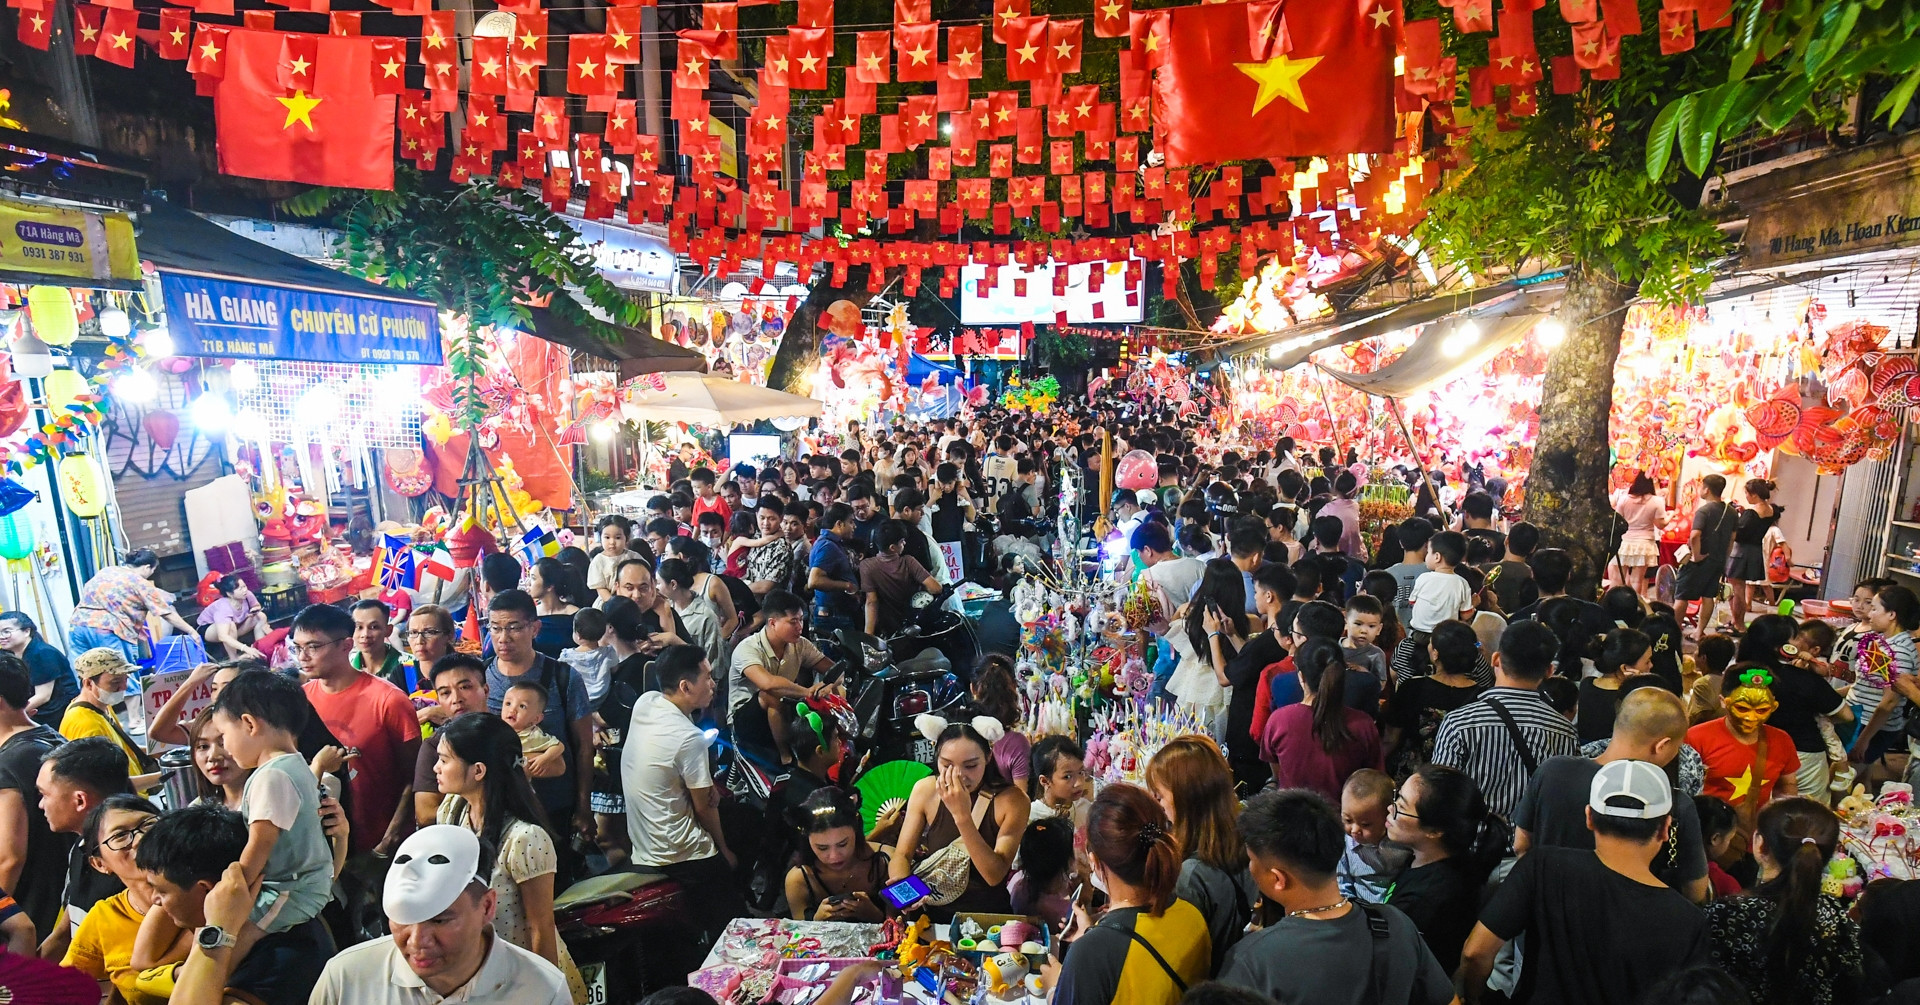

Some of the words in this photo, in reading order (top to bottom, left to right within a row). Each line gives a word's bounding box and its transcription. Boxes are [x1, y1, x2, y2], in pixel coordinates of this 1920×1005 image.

[20, 225, 38, 238] 71A
[40, 227, 64, 243] Hàng
[66, 231, 80, 243] Mã
[1784, 234, 1816, 253] Hang
[1818, 227, 1843, 247] Ma,
[1845, 221, 1882, 242] Hoan
[23, 246, 46, 259] 0931
[49, 249, 65, 260] 387
[68, 251, 84, 263] 931
[184, 288, 216, 320] HÀ
[220, 295, 279, 326] GIANG
[290, 308, 356, 335] CHUYÊN
[359, 311, 379, 336] CỜ
[202, 340, 224, 353] 71B
[227, 338, 256, 354] HÀNG
[164, 672, 190, 684] NATION
[588, 985, 603, 1004] 86
